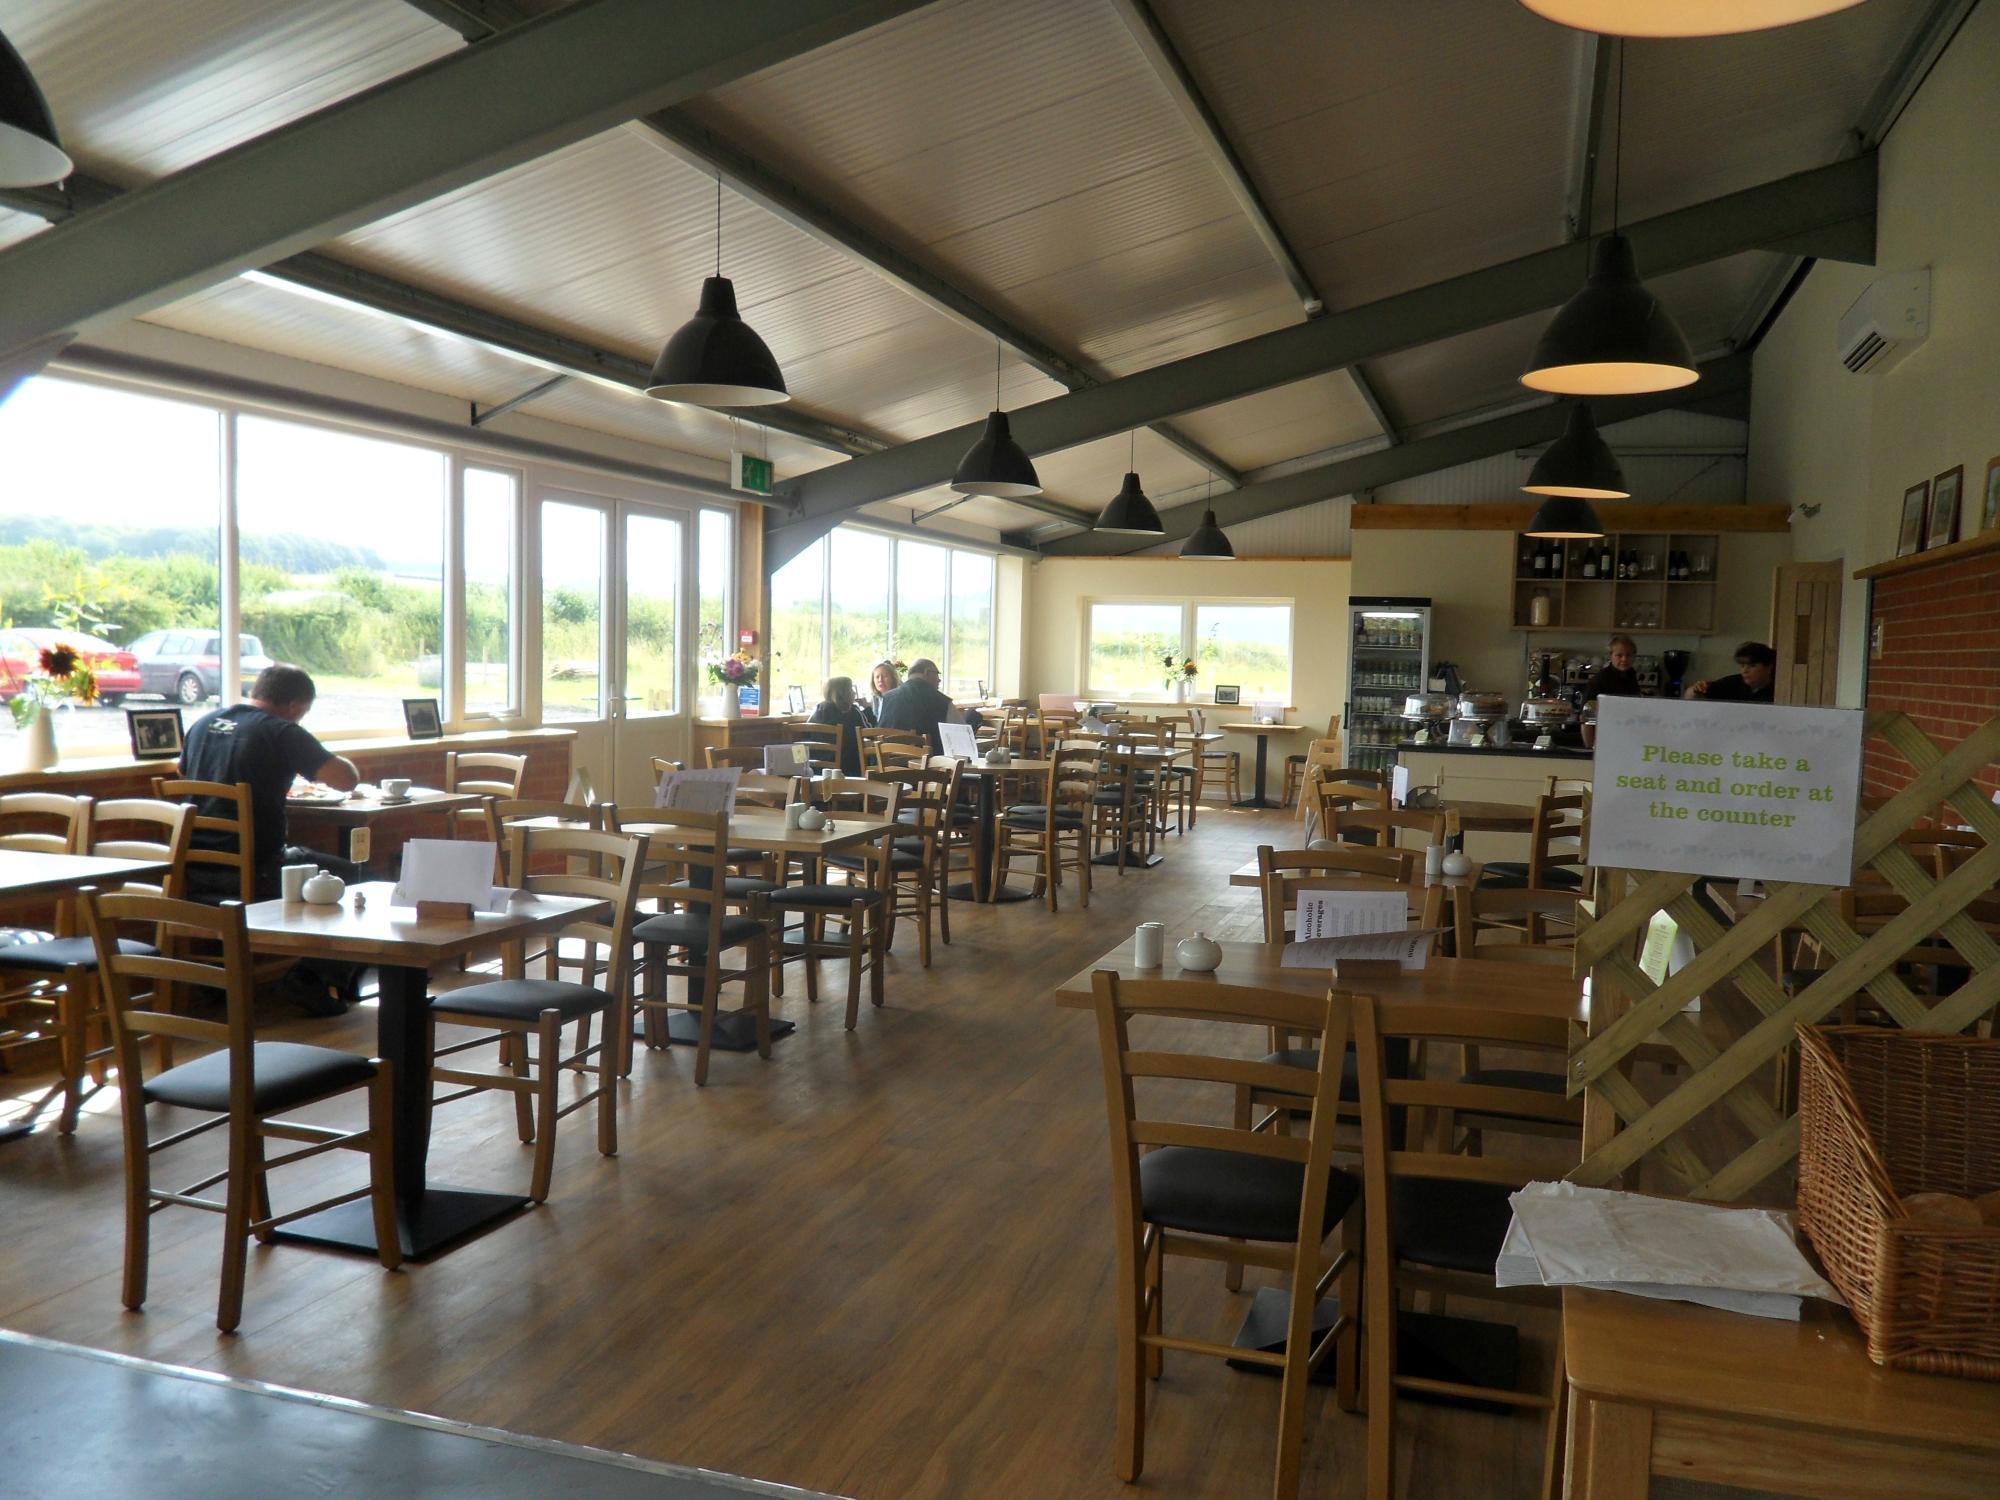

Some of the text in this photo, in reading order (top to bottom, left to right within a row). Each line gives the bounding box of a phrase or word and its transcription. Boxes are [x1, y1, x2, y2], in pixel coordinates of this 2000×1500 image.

[1641, 744, 1811, 773] Please take a
[1615, 773, 1834, 802] seat and order at
[1649, 800, 1797, 828] the counter
[1316, 900, 1325, 937] everages
